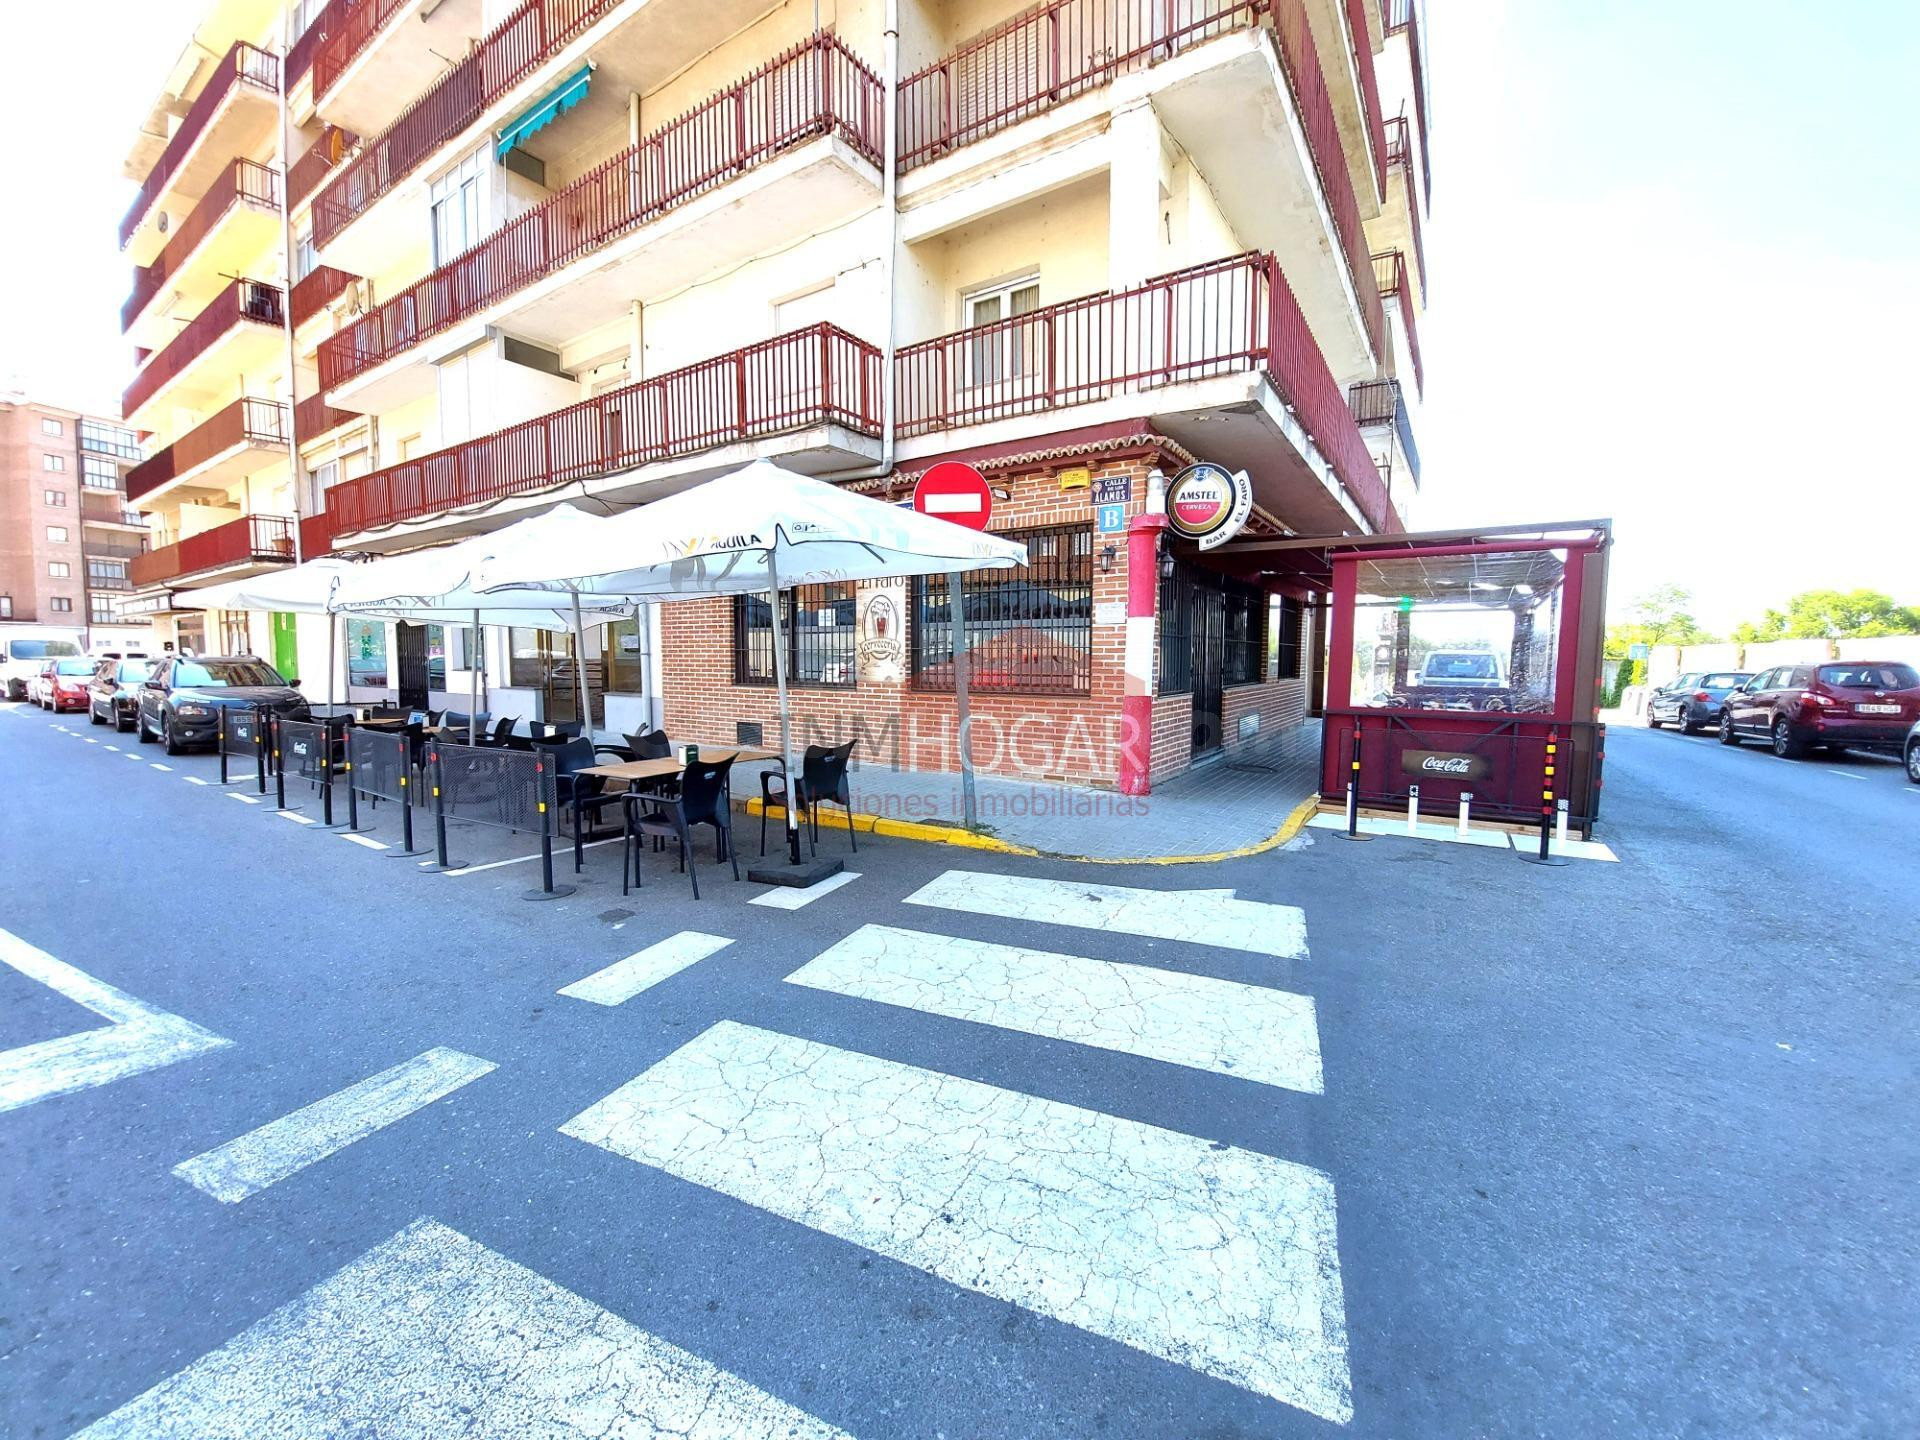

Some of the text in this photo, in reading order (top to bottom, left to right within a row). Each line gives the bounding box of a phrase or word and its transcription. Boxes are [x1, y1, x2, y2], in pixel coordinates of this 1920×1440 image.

[1104, 478, 1127, 487] CALLE
[1180, 490, 1217, 501] AMSTEL
[1181, 503, 1212, 511] CERVEZA
[1205, 478, 1248, 545] BAR EL FARO
[1103, 509, 1119, 529] B
